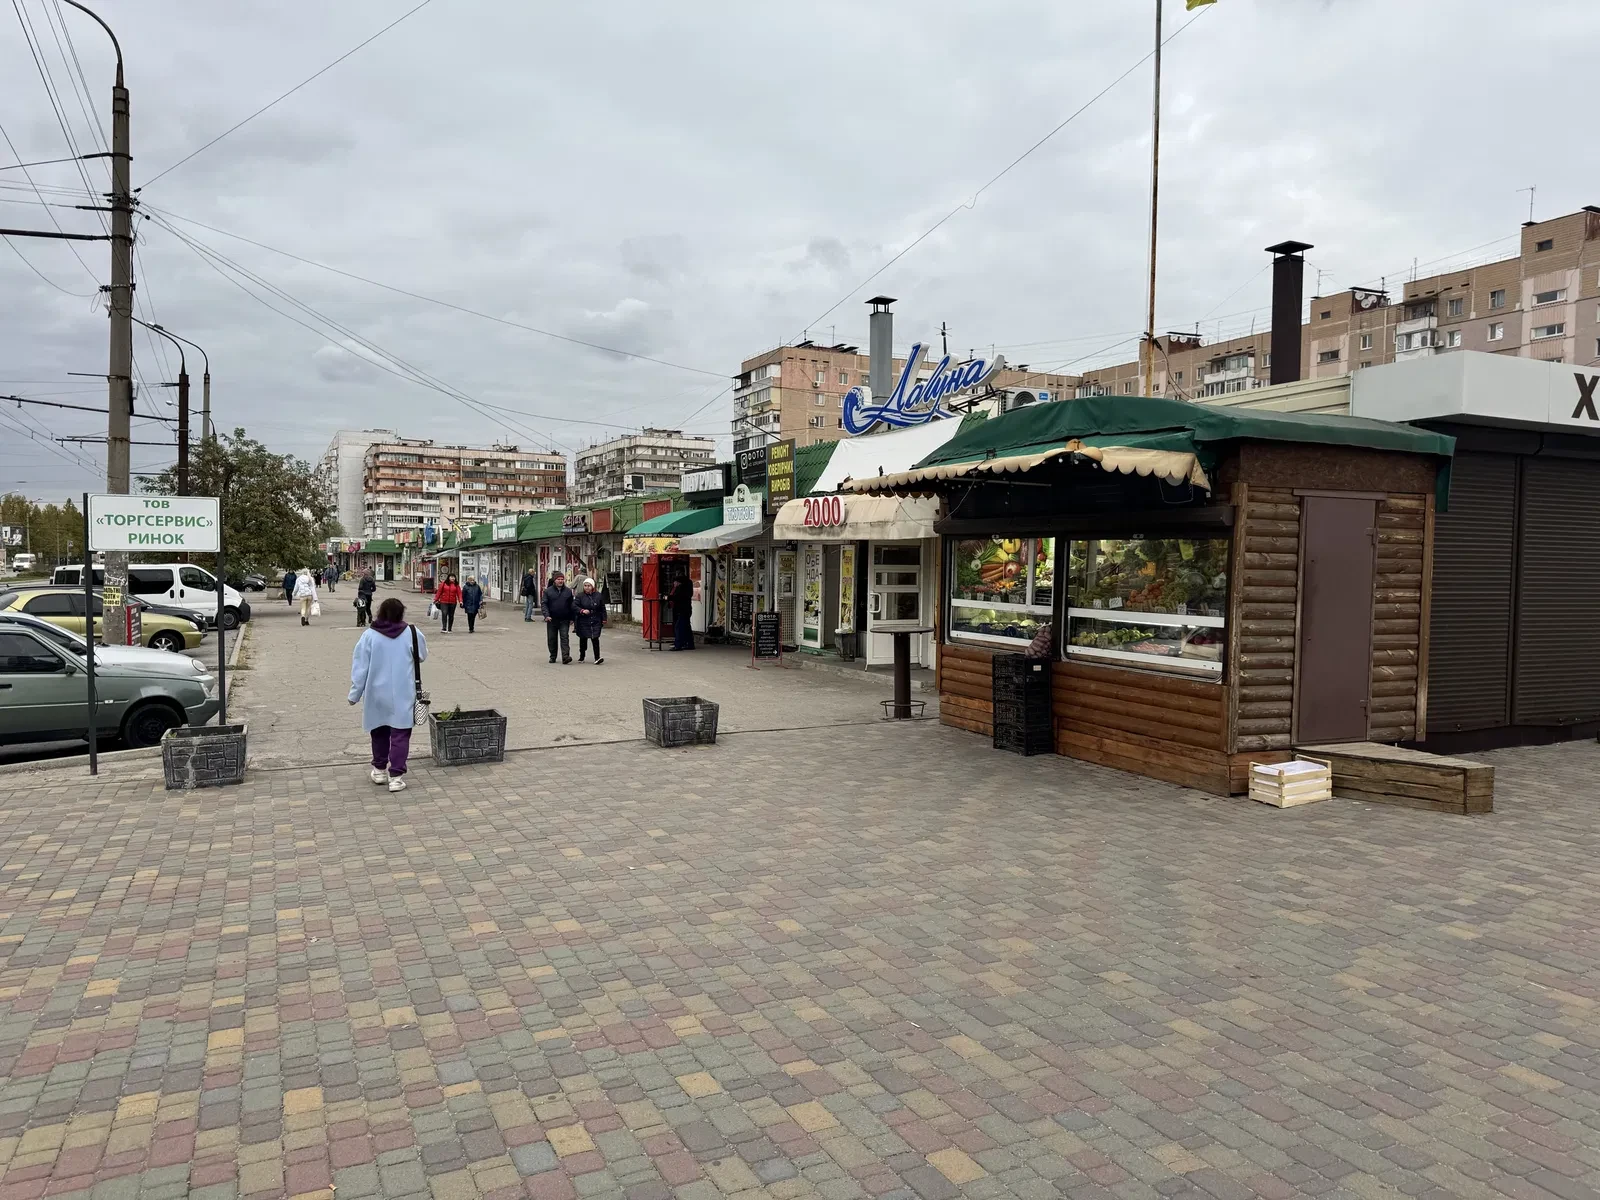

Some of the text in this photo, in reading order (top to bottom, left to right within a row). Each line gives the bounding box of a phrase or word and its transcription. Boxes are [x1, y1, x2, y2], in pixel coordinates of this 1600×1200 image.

[748, 449, 765, 461] ФОТО
[771, 444, 790, 460] РЕМОНТ
[767, 460, 794, 477] ЮВЕЛІРНИХ
[771, 478, 791, 492] ВИРОБІВ
[142, 499, 171, 509] ТОВ
[727, 505, 756, 521] ТЮТЮН
[803, 495, 842, 528] 2000
[96, 514, 214, 528] «ТОРГСЕРВИС»
[128, 532, 185, 545] РИНОК
